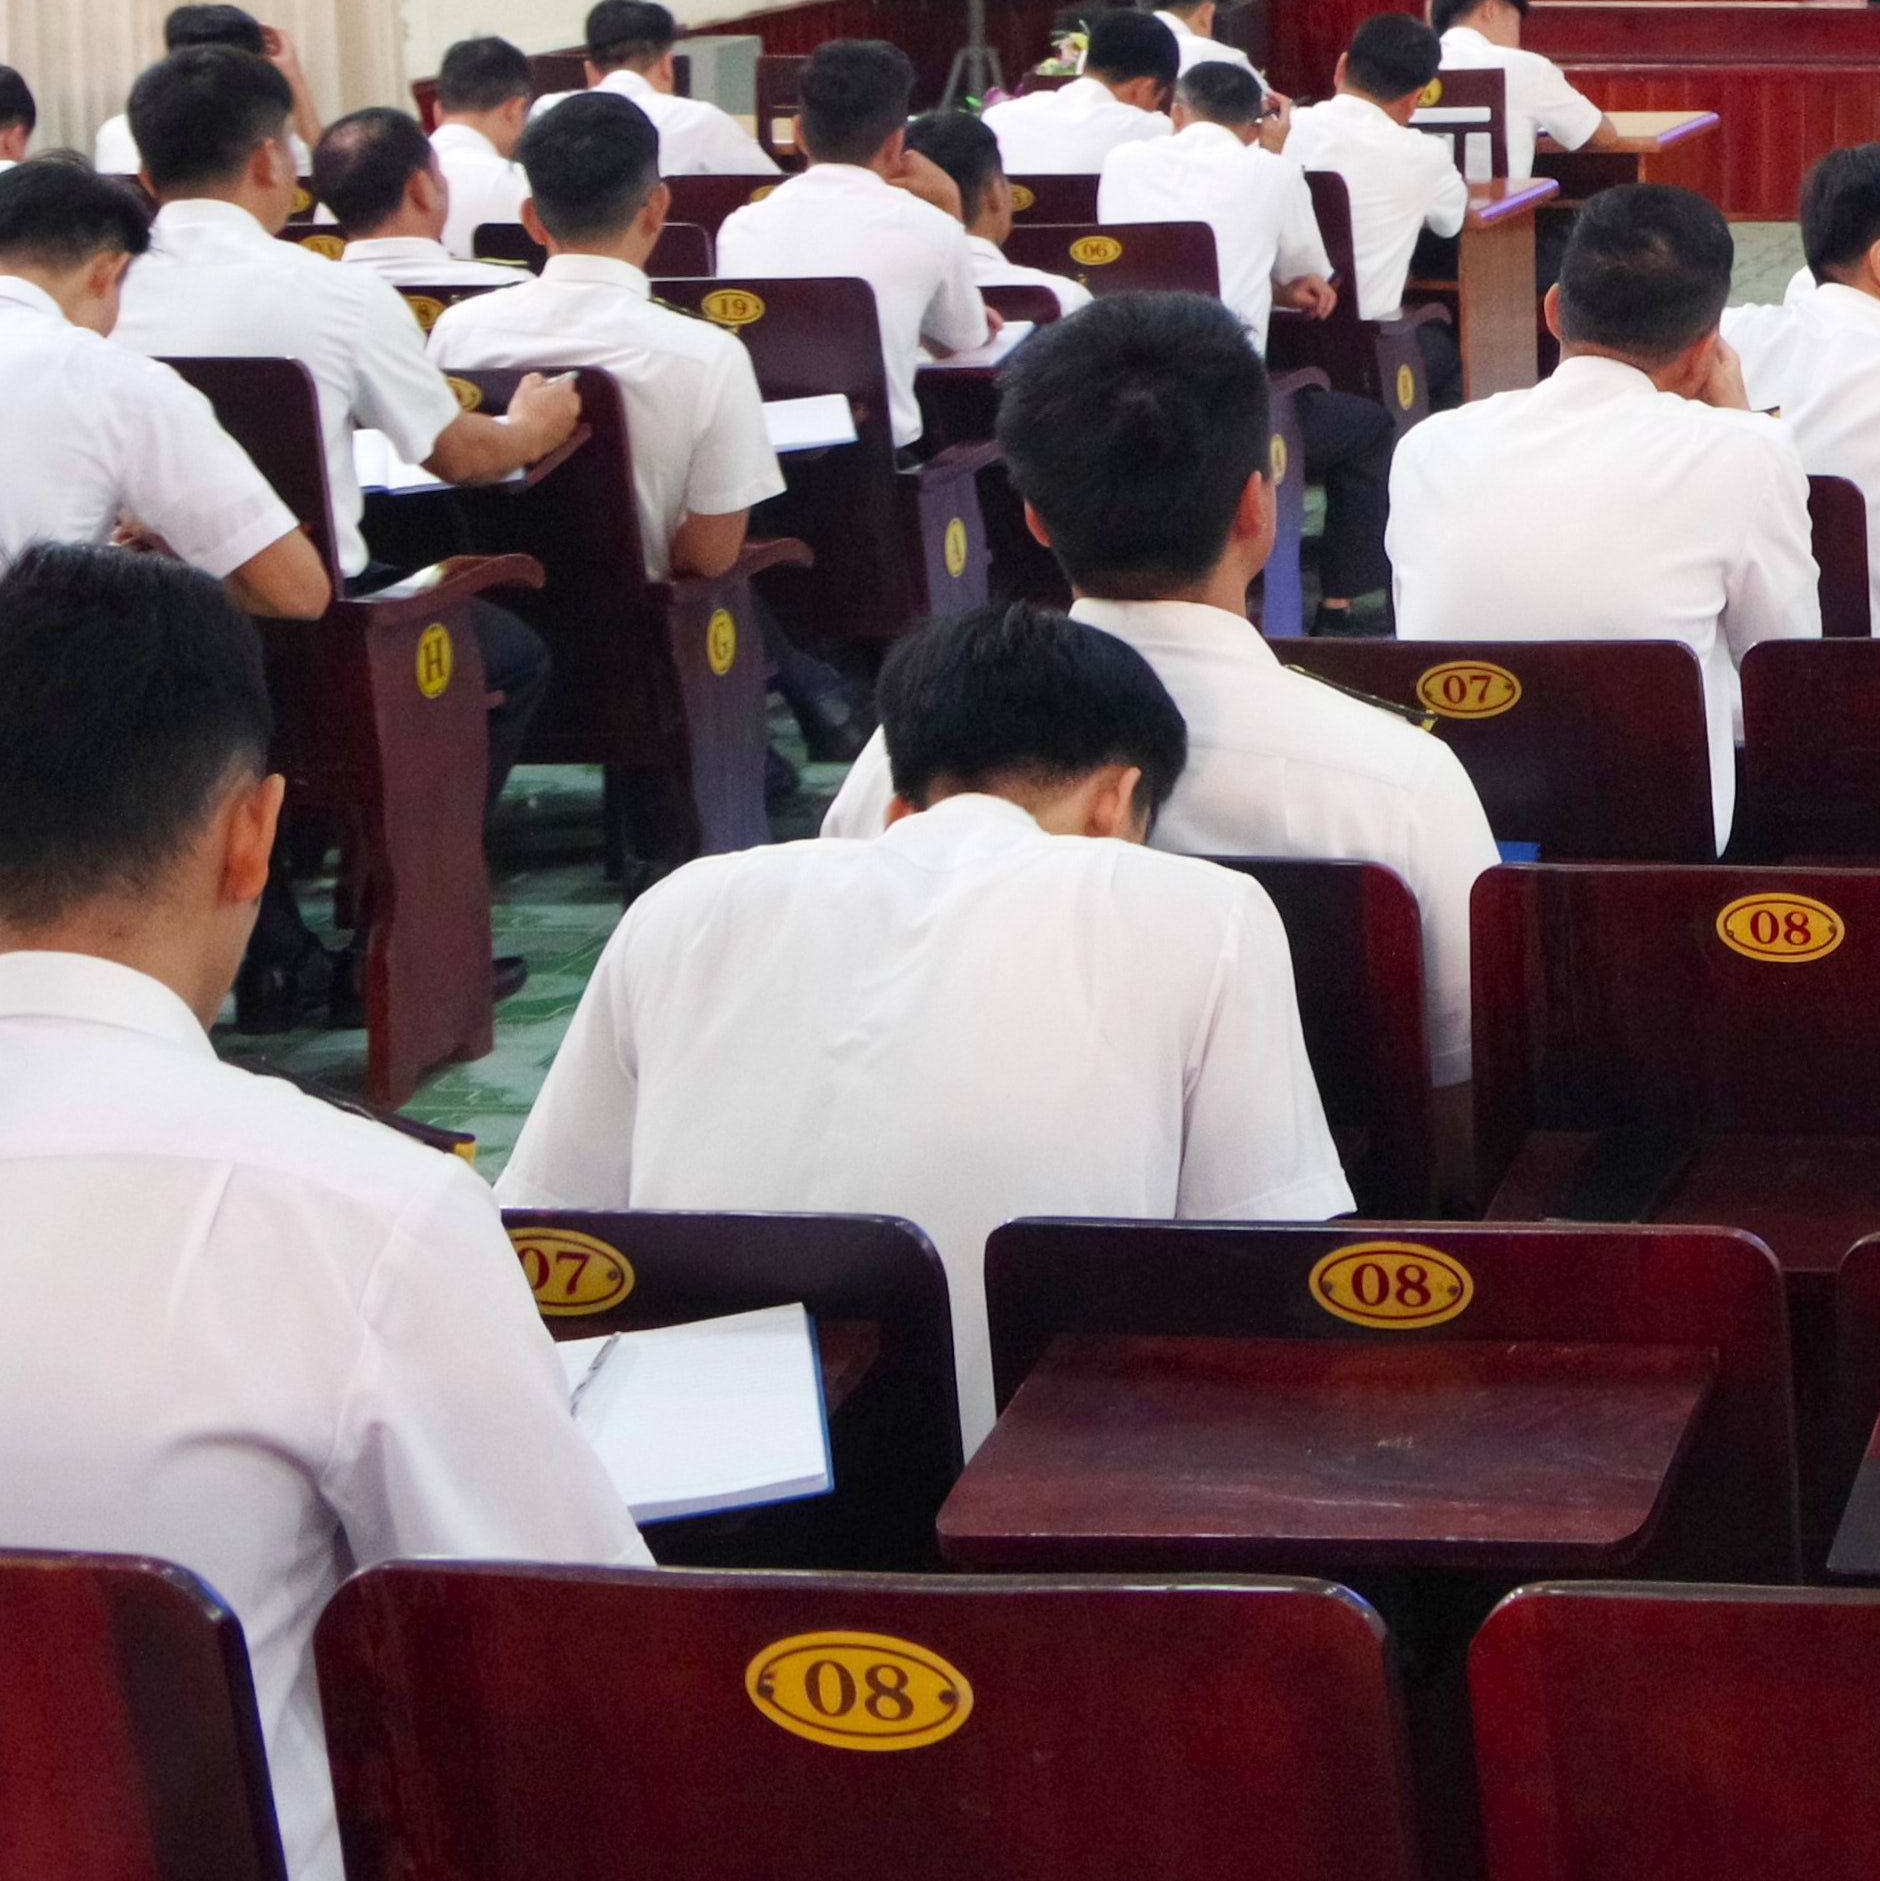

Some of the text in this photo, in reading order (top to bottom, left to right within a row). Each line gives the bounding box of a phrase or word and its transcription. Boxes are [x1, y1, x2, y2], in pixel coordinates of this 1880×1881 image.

[423, 640, 445, 682] H
[1442, 675, 1493, 703] 07
[1749, 910, 1813, 947] 08
[520, 1248, 591, 1296] 07
[1351, 1263, 1433, 1308] 08
[803, 1660, 915, 1724] 08
